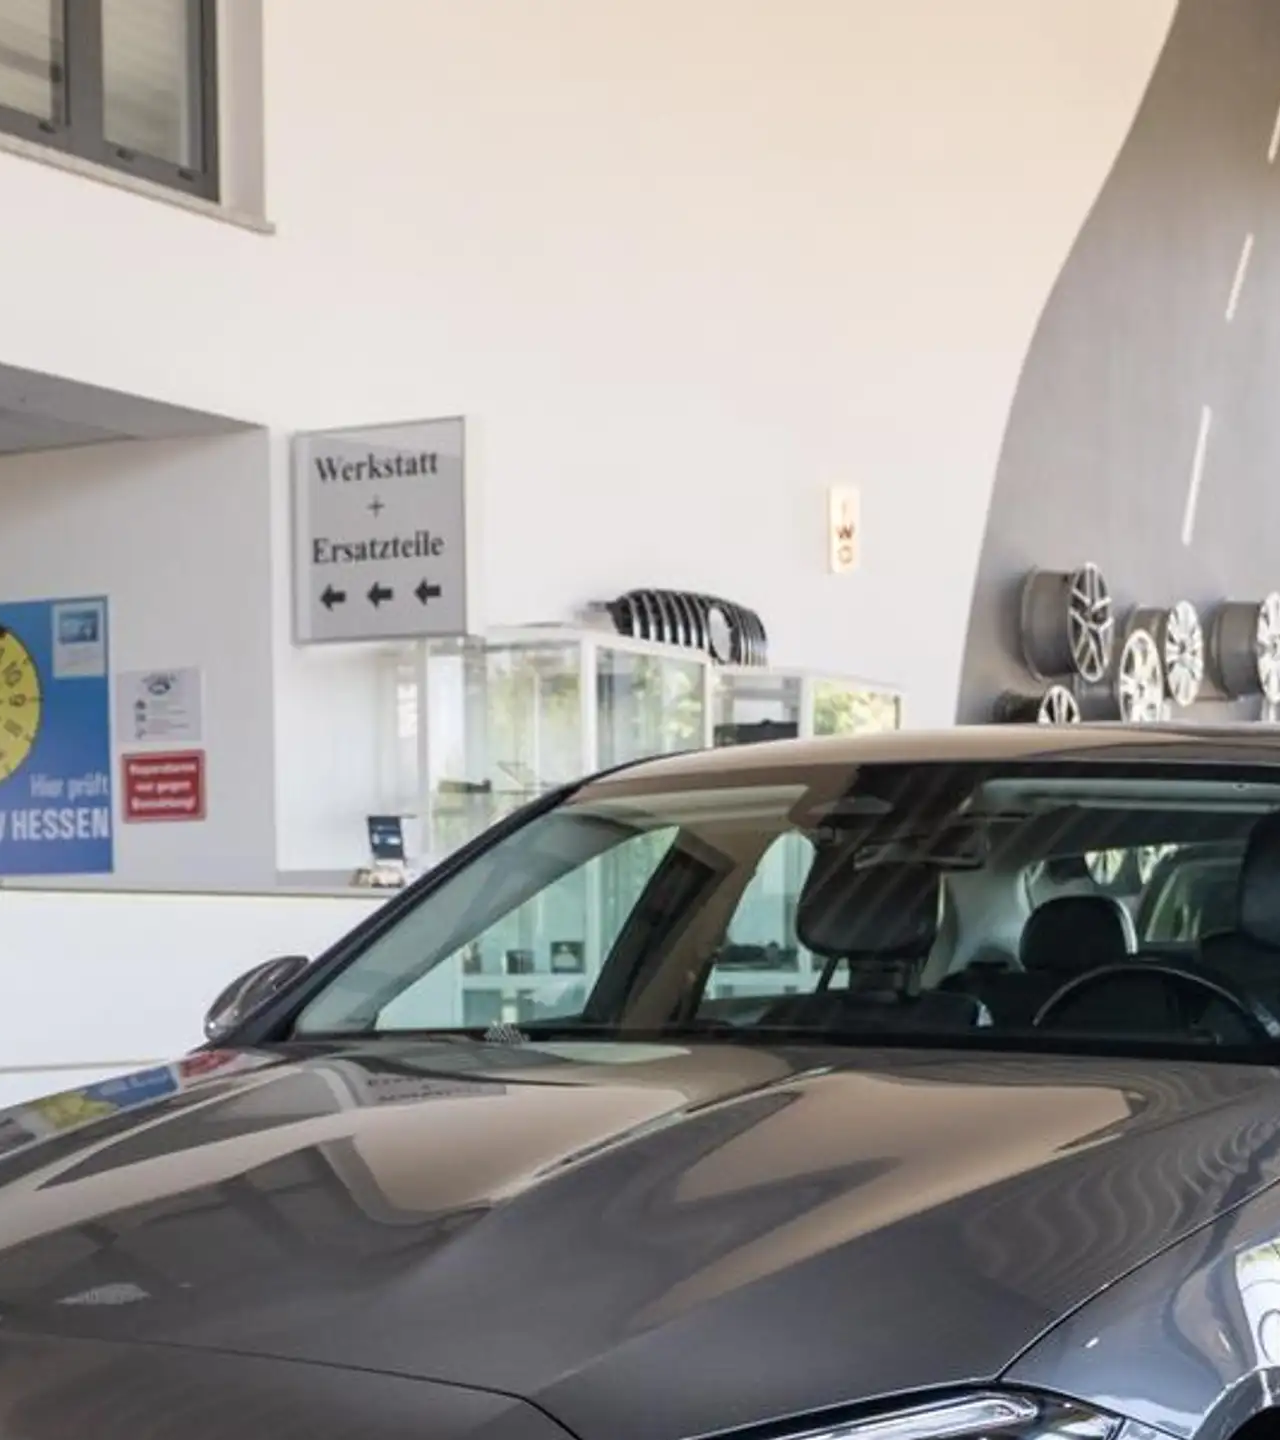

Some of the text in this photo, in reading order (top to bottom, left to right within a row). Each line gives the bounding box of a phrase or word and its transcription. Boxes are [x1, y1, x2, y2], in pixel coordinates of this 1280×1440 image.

[313, 452, 438, 483] Werkstatt
[312, 529, 446, 565] Ersatzteile
[30, 771, 109, 803] Hier prüft
[11, 806, 111, 841] HESSEN
